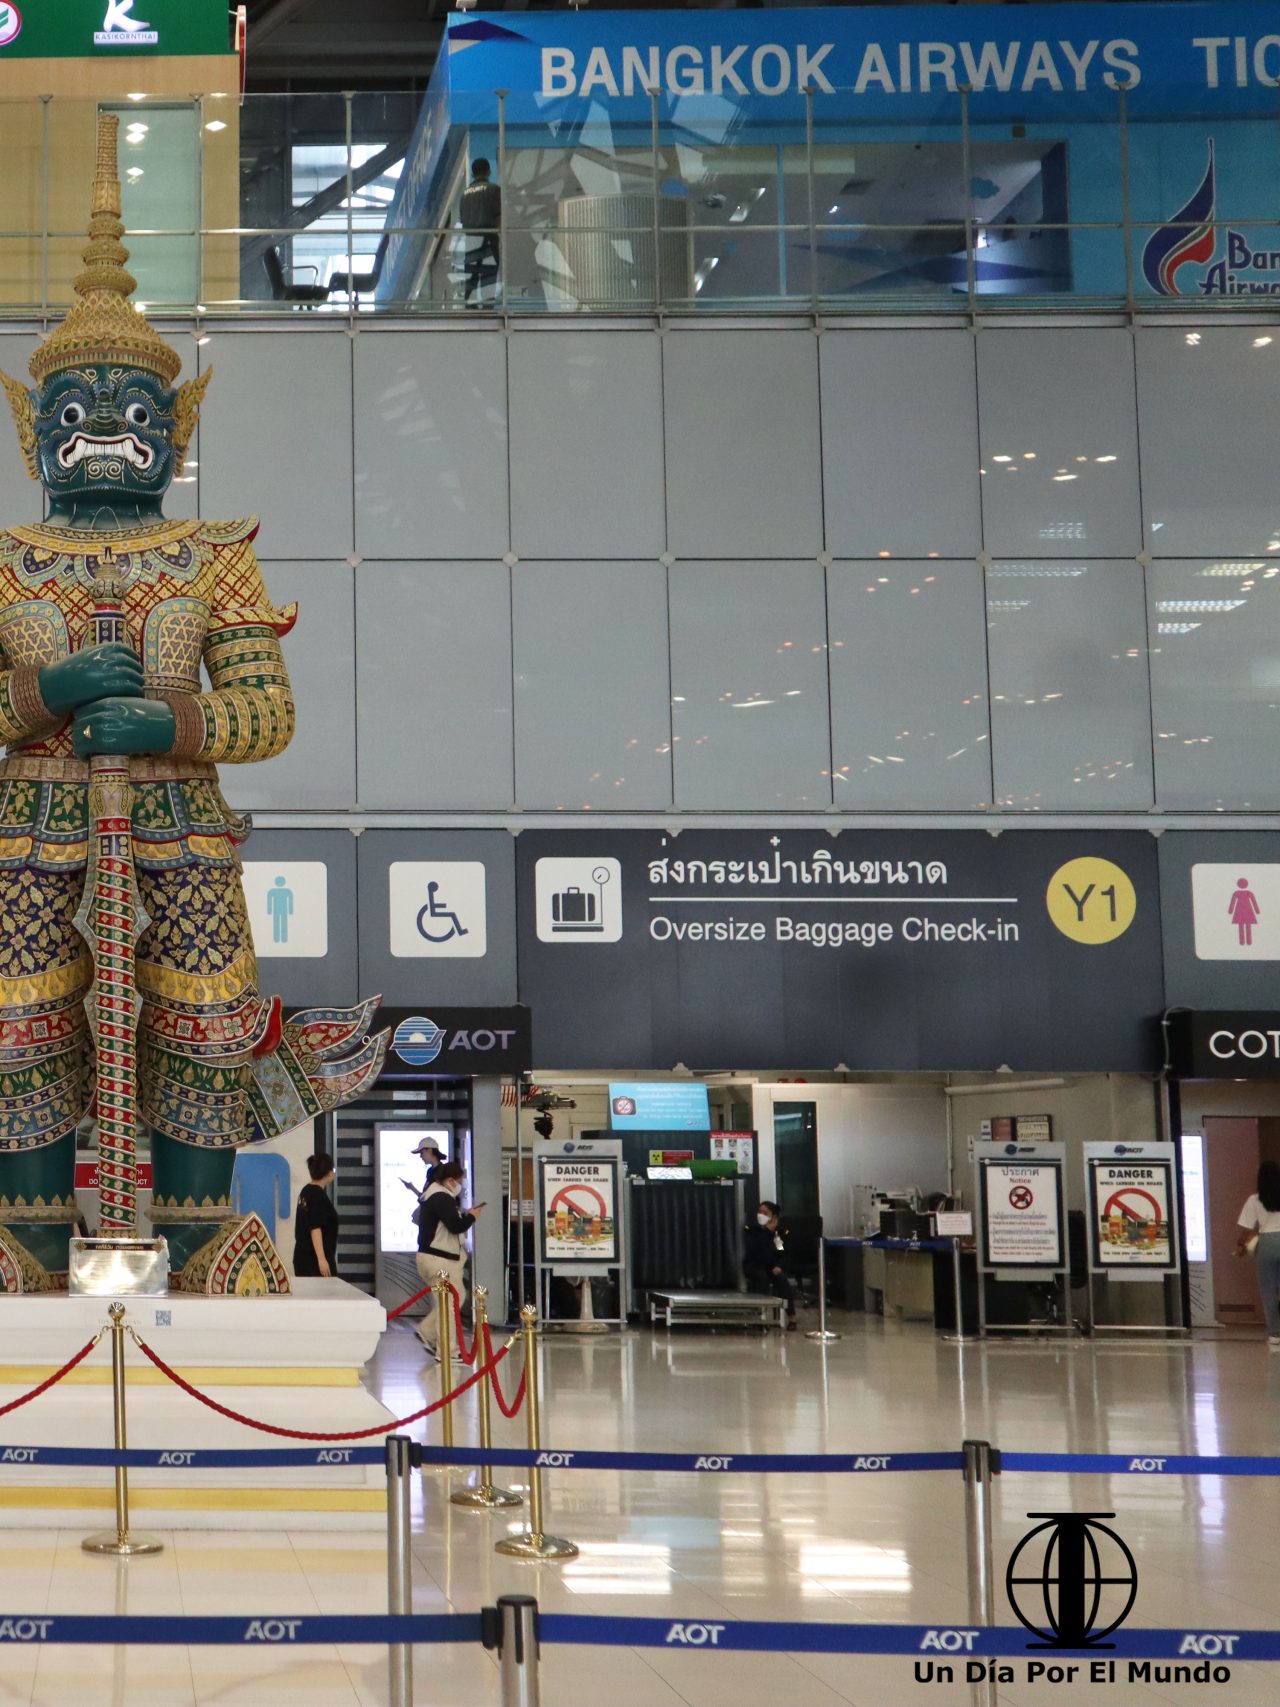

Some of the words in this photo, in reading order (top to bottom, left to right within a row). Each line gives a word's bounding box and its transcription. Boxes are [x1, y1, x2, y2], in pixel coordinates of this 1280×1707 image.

[95, 33, 156, 41] KASIKORNTHAI
[541, 43, 836, 97] BANGKOK
[854, 38, 1141, 94] AIRWAYS
[648, 836, 948, 884] ส่งกระเป๋าเกินขนาด
[1061, 883, 1117, 922] Y1
[650, 916, 766, 942] Oversize
[775, 916, 894, 947] Baggage
[901, 916, 1020, 942] Check-in
[448, 1029, 517, 1051] AOT
[556, 1166, 600, 1175] DANGER
[1001, 1166, 1040, 1176] ประกาศ
[1109, 1169, 1153, 1178] DANGER
[2, 1449, 38, 1462] AOT
[159, 1452, 195, 1466] AOT
[317, 1450, 353, 1463] AOT
[536, 1453, 574, 1466] AOT
[696, 1456, 732, 1469] AOT
[854, 1456, 891, 1469] AOT
[1131, 1459, 1167, 1472] AOT
[244, 1619, 302, 1640] AOT
[666, 1623, 725, 1645] AOT
[920, 1630, 980, 1651] AOT
[1179, 1635, 1239, 1656] AOT
